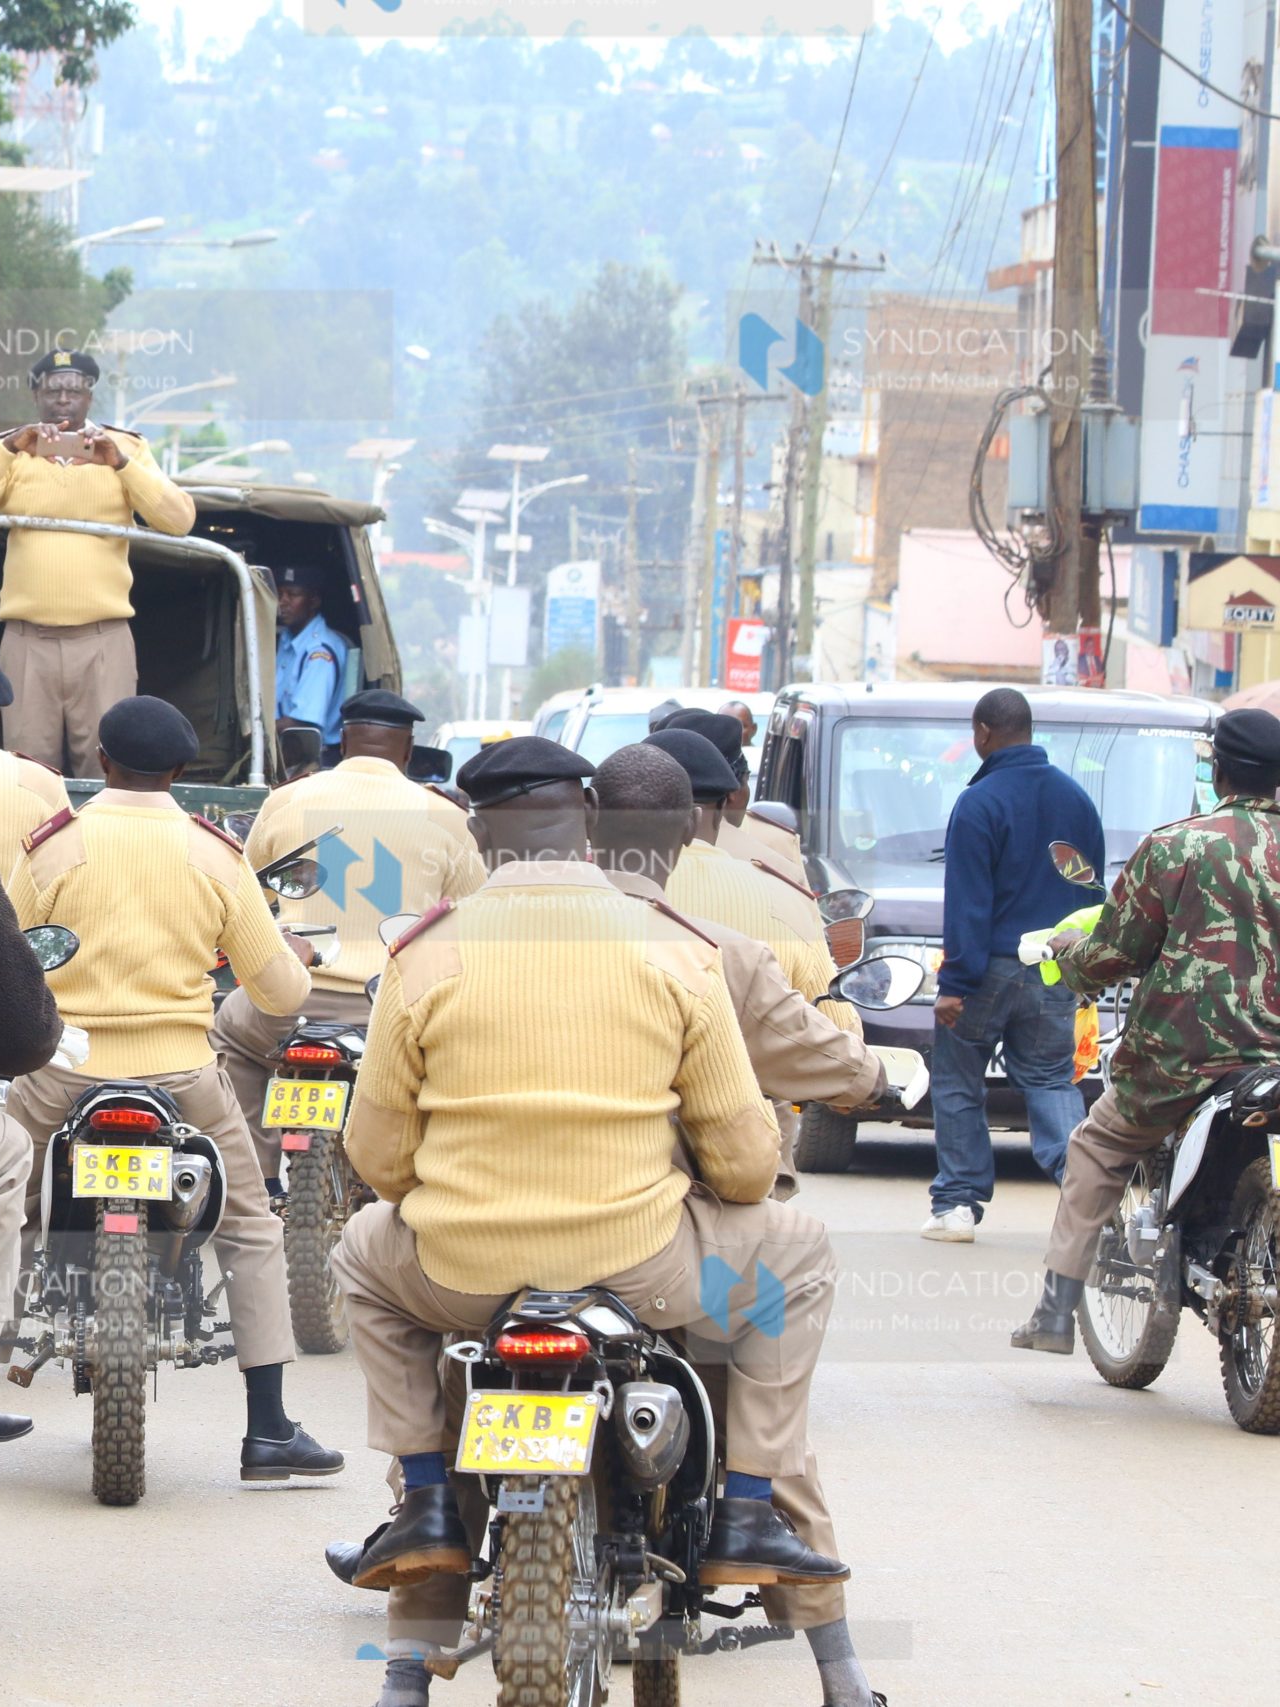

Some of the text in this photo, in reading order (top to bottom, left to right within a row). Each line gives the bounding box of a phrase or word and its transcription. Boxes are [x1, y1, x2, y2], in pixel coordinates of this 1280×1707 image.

[1223, 607, 1276, 623] EQUITY
[275, 1087, 320, 1102] GKB
[271, 1105, 336, 1123] 459N
[86, 1154, 142, 1172] GKB
[83, 1174, 163, 1192] 205N
[477, 1404, 553, 1430] GKB
